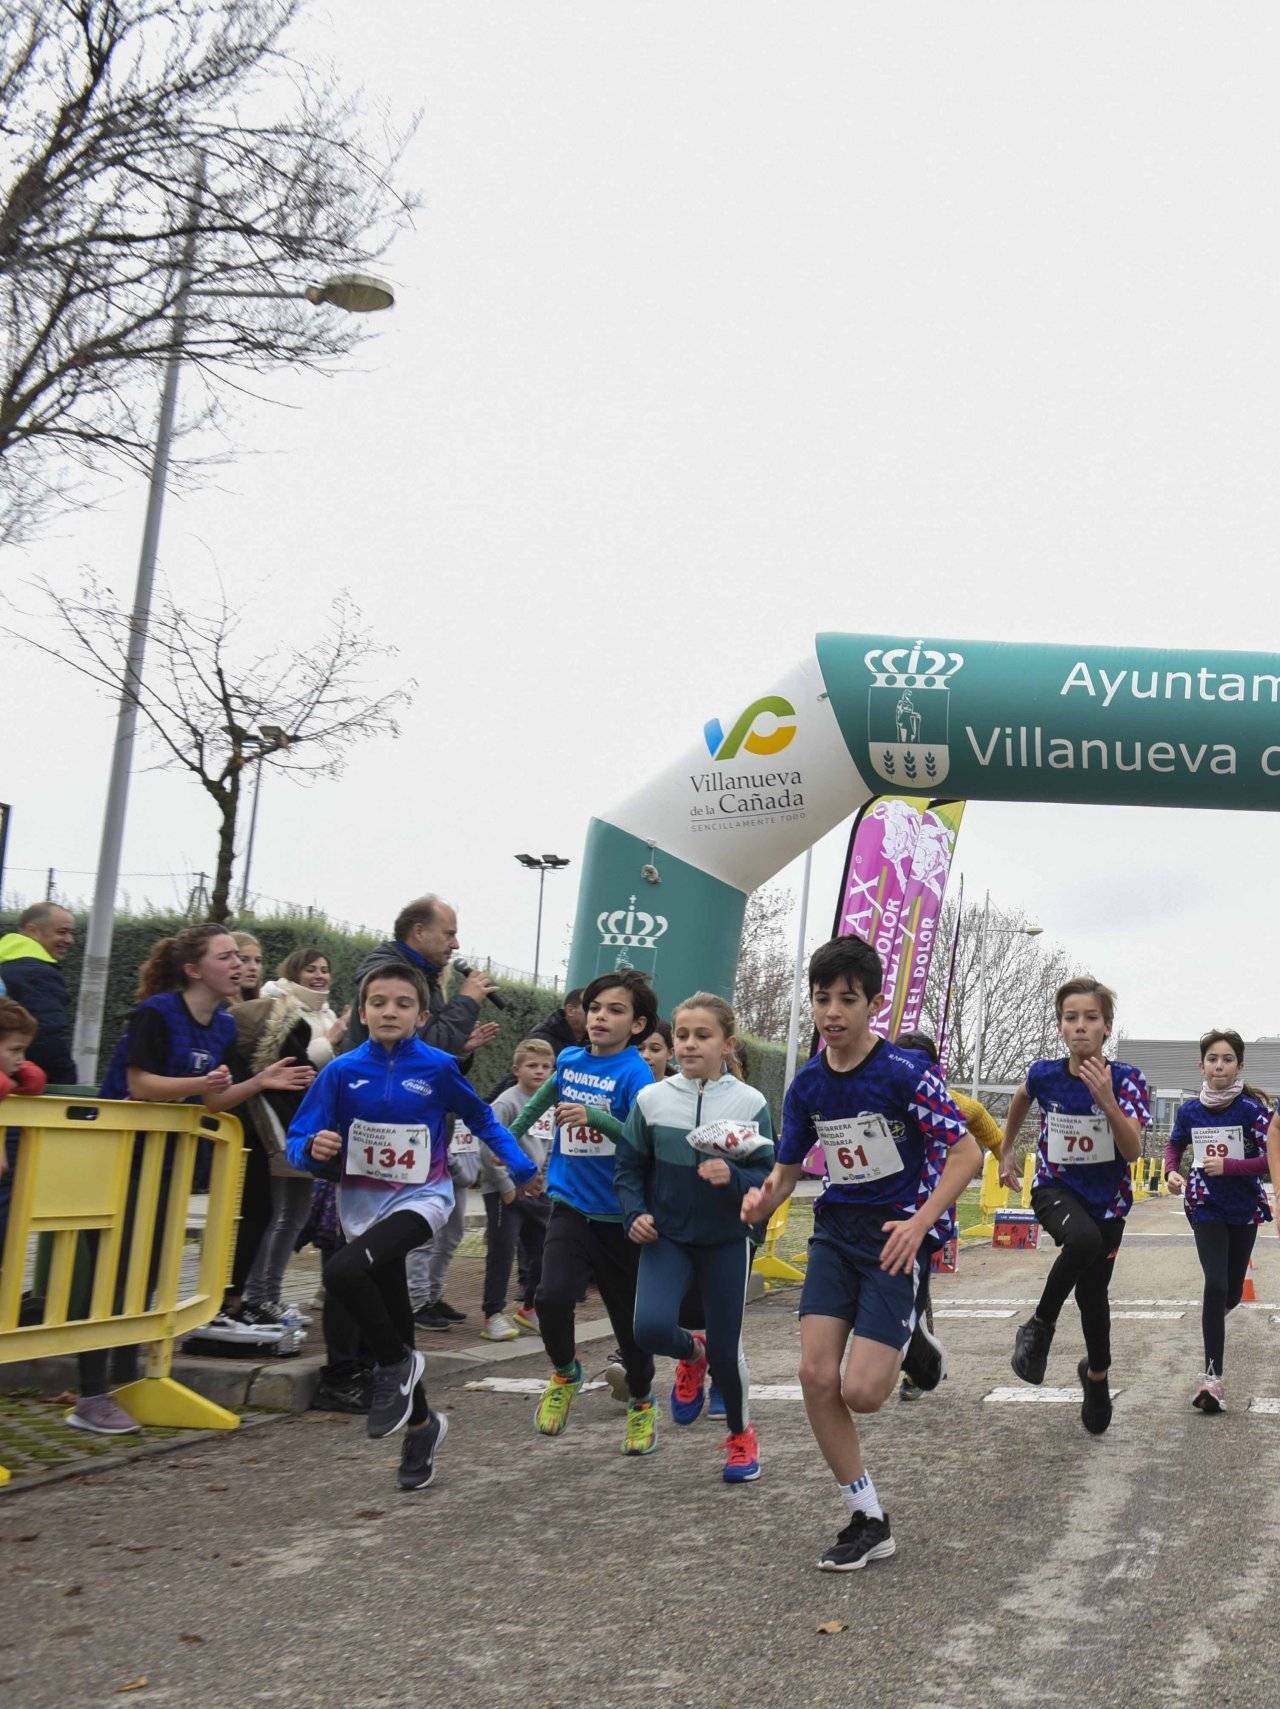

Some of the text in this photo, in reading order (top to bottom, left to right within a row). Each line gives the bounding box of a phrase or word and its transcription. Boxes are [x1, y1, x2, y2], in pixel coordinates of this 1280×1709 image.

[965, 726, 1237, 775] Villanueva
[690, 771, 802, 792] Villanueva
[690, 789, 804, 816] de la Cañada
[690, 812, 806, 832] SENCILLAMENTE TODO
[901, 1010, 917, 1033] UE
[913, 917, 935, 978] DOLOR
[566, 1126, 604, 1144] 148
[1064, 1136, 1093, 1152] 70
[363, 1146, 415, 1169] 134
[837, 1145, 869, 1169] 61
[1206, 1143, 1229, 1157] 69
